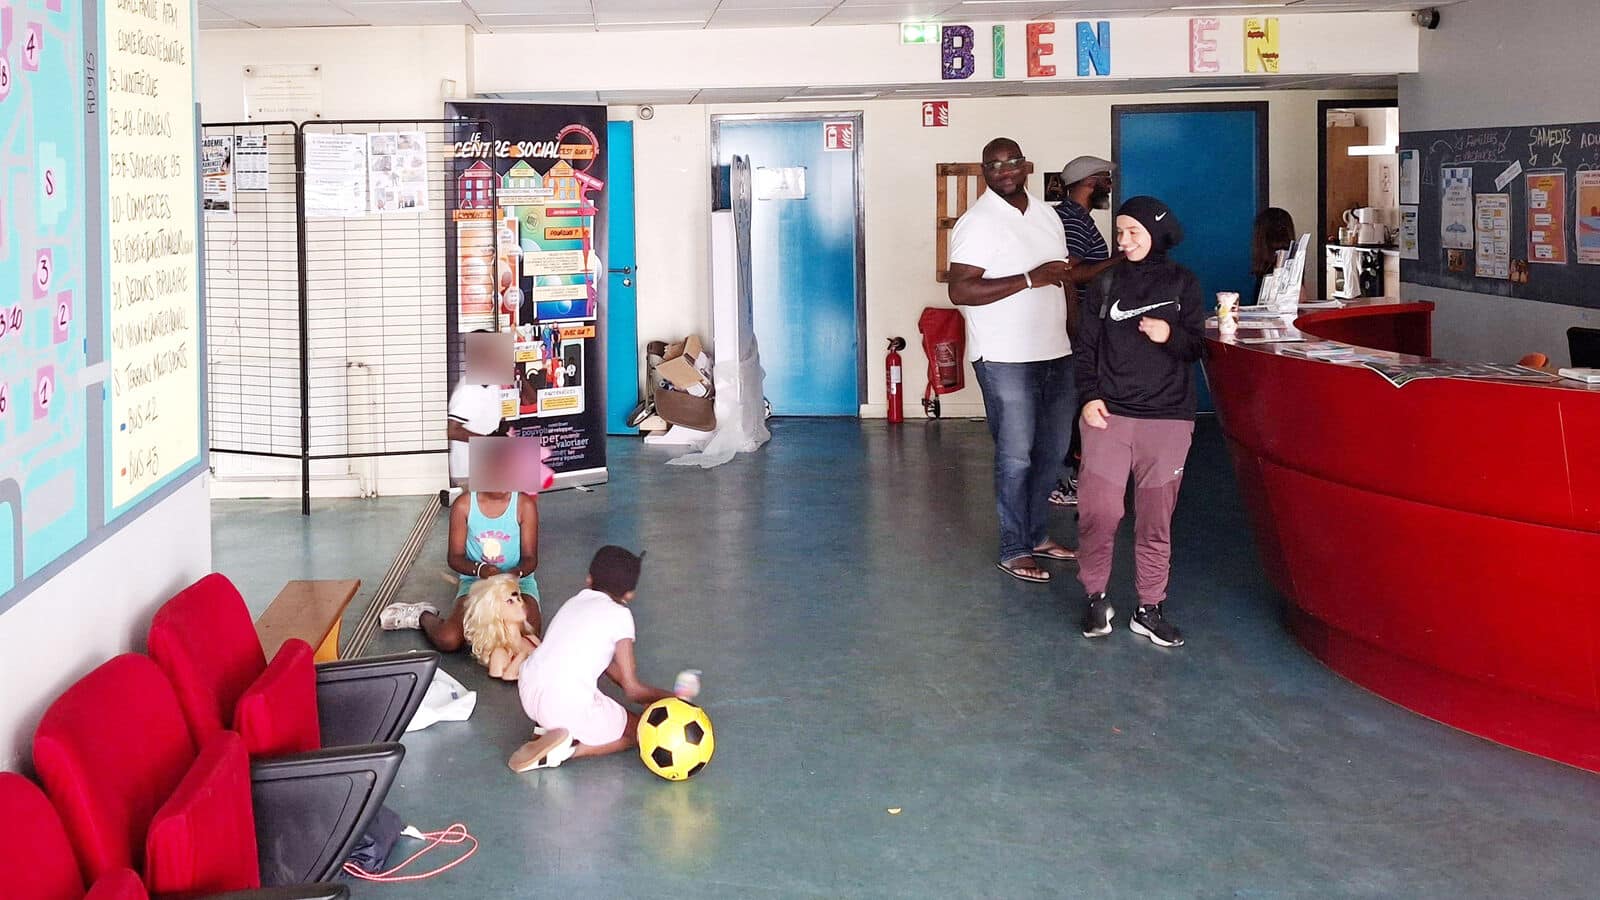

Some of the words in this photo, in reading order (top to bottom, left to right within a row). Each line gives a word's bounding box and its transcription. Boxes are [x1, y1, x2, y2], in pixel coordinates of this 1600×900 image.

[27, 33, 35, 60] 4
[942, 21, 1110, 80] BIEN
[470, 132, 481, 142] LE
[1528, 127, 1571, 148] SAMEDIS
[455, 140, 510, 158] CENTRE
[516, 141, 561, 158] SOCIAL
[40, 259, 48, 285] 3
[60, 304, 67, 326] 2
[40, 381, 48, 405] 1
[128, 404, 143, 434] BUS
[556, 438, 589, 448] valoriser
